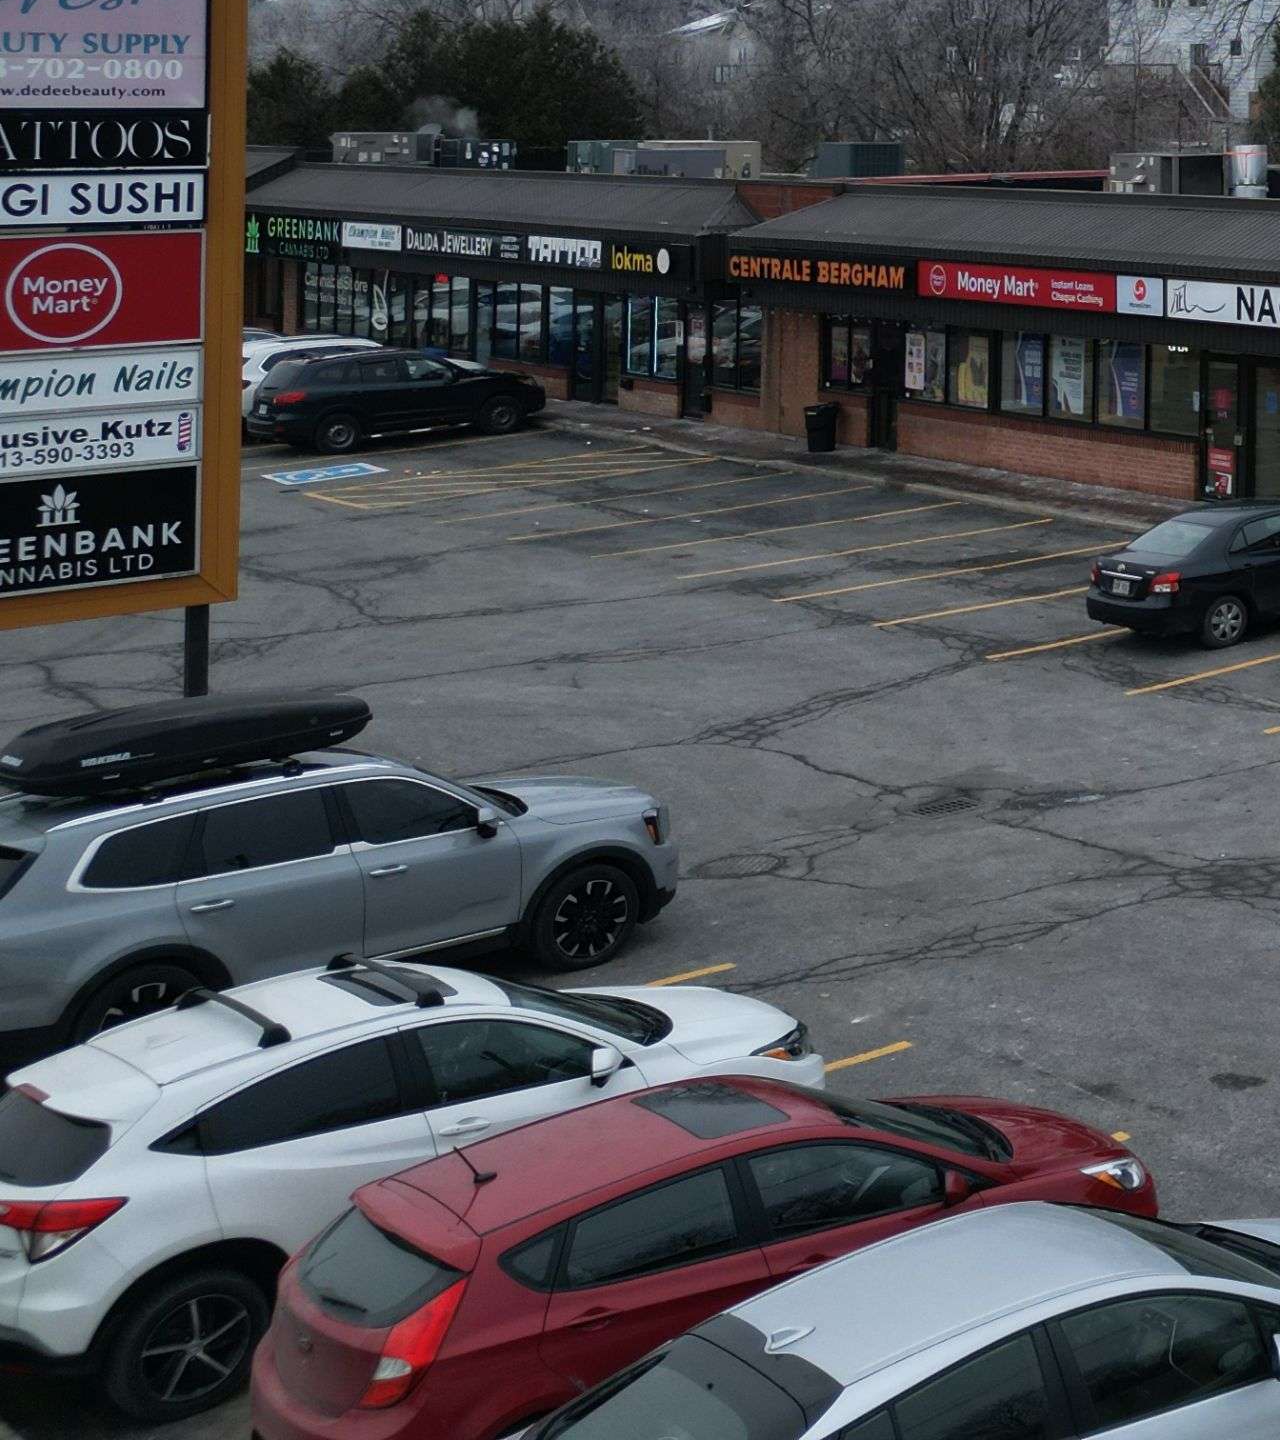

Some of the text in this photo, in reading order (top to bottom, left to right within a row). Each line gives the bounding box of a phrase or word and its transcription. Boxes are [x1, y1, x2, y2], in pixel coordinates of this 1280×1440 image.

[0, 31, 192, 54] UTY SUPPLY
[69, 182, 194, 215] SUSHI
[267, 217, 340, 242] GREENBANK
[611, 245, 653, 273] lokma
[729, 256, 905, 289] CENTRALE BERGHAM
[957, 271, 1000, 299] Money
[23, 276, 108, 296] Money
[32, 296, 92, 315] Mart
[113, 361, 194, 393] Nails
[109, 554, 153, 573] LTD
